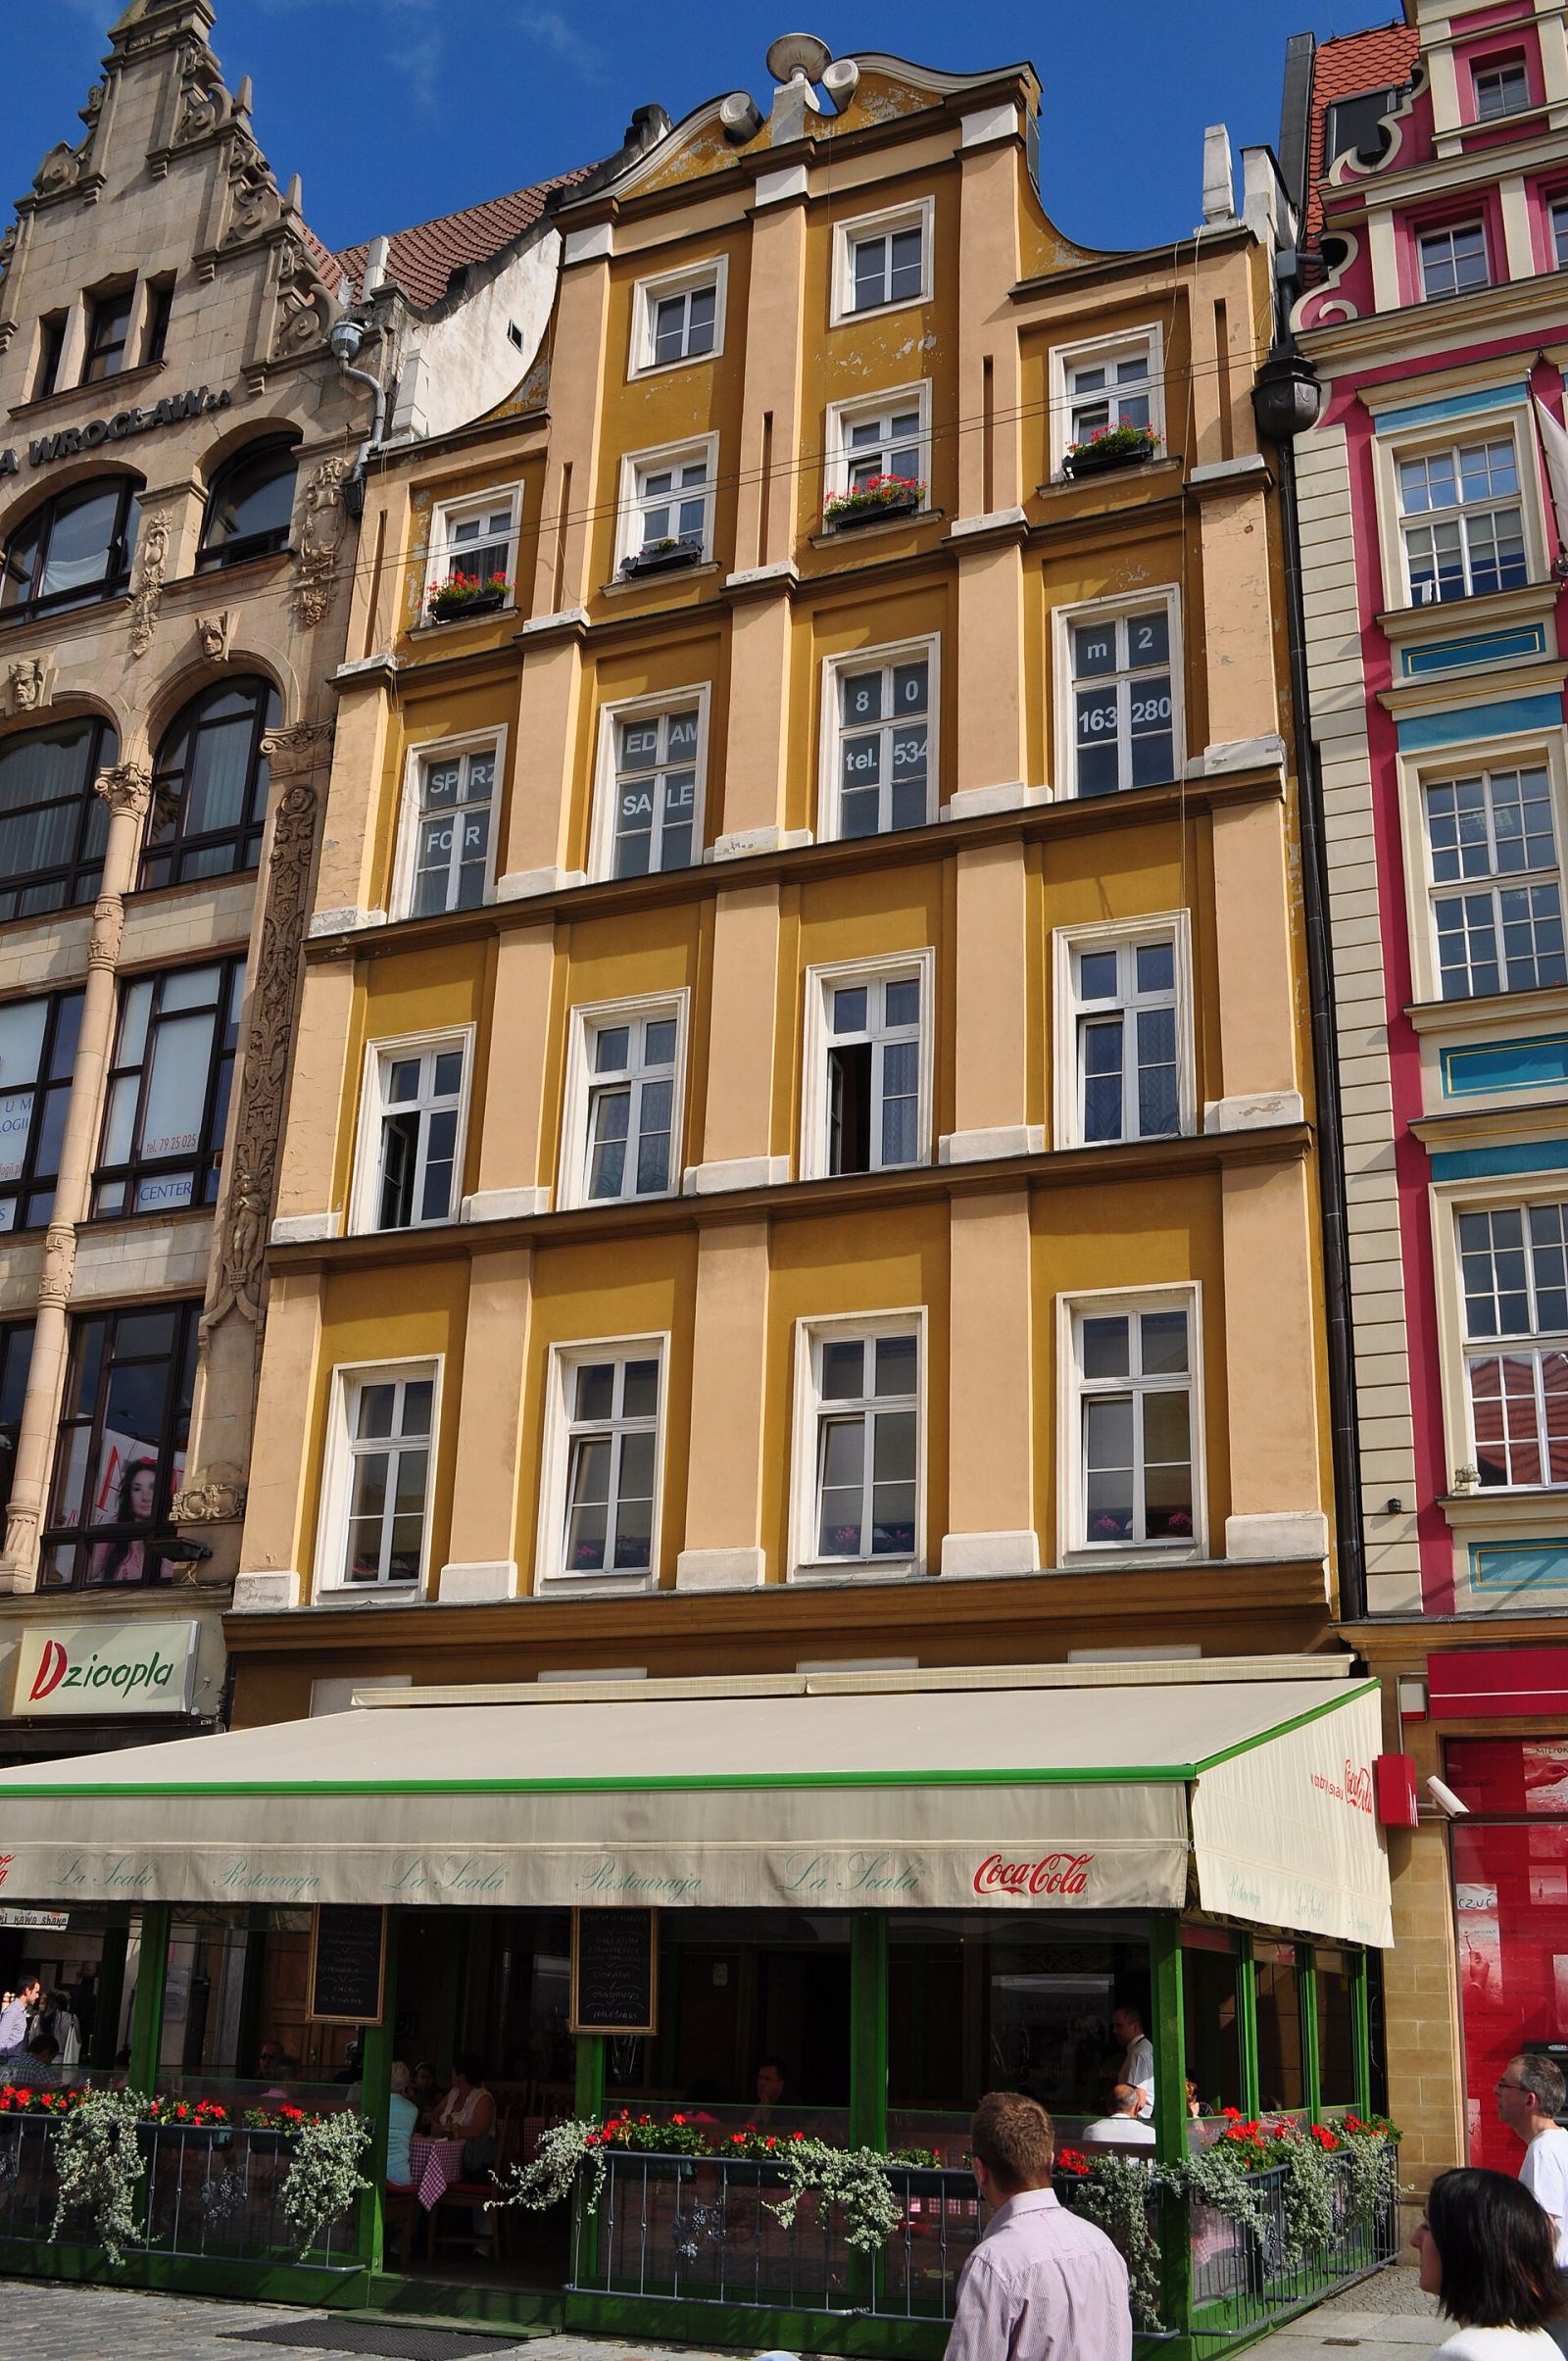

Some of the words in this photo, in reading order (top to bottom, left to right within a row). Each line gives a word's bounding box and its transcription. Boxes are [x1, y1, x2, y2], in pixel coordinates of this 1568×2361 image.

[28, 386, 209, 467] WROCŁAW
[846, 748, 878, 771] tel.
[622, 785, 694, 815] SALE
[426, 825, 480, 854] FOR
[140, 1181, 192, 1201] CENTER
[28, 1640, 174, 1702] Dzioopla
[49, 1851, 86, 1887] La
[93, 1851, 154, 1887] Scala
[381, 1852, 425, 1891] La
[433, 1852, 507, 1892] Scala
[575, 1854, 703, 1903] Restauracja
[775, 1850, 827, 1892] La
[836, 1850, 921, 1893] Scala
[973, 1853, 1095, 1895] Coca-Cola
[1458, 1892, 1494, 1909] CZUĆ
